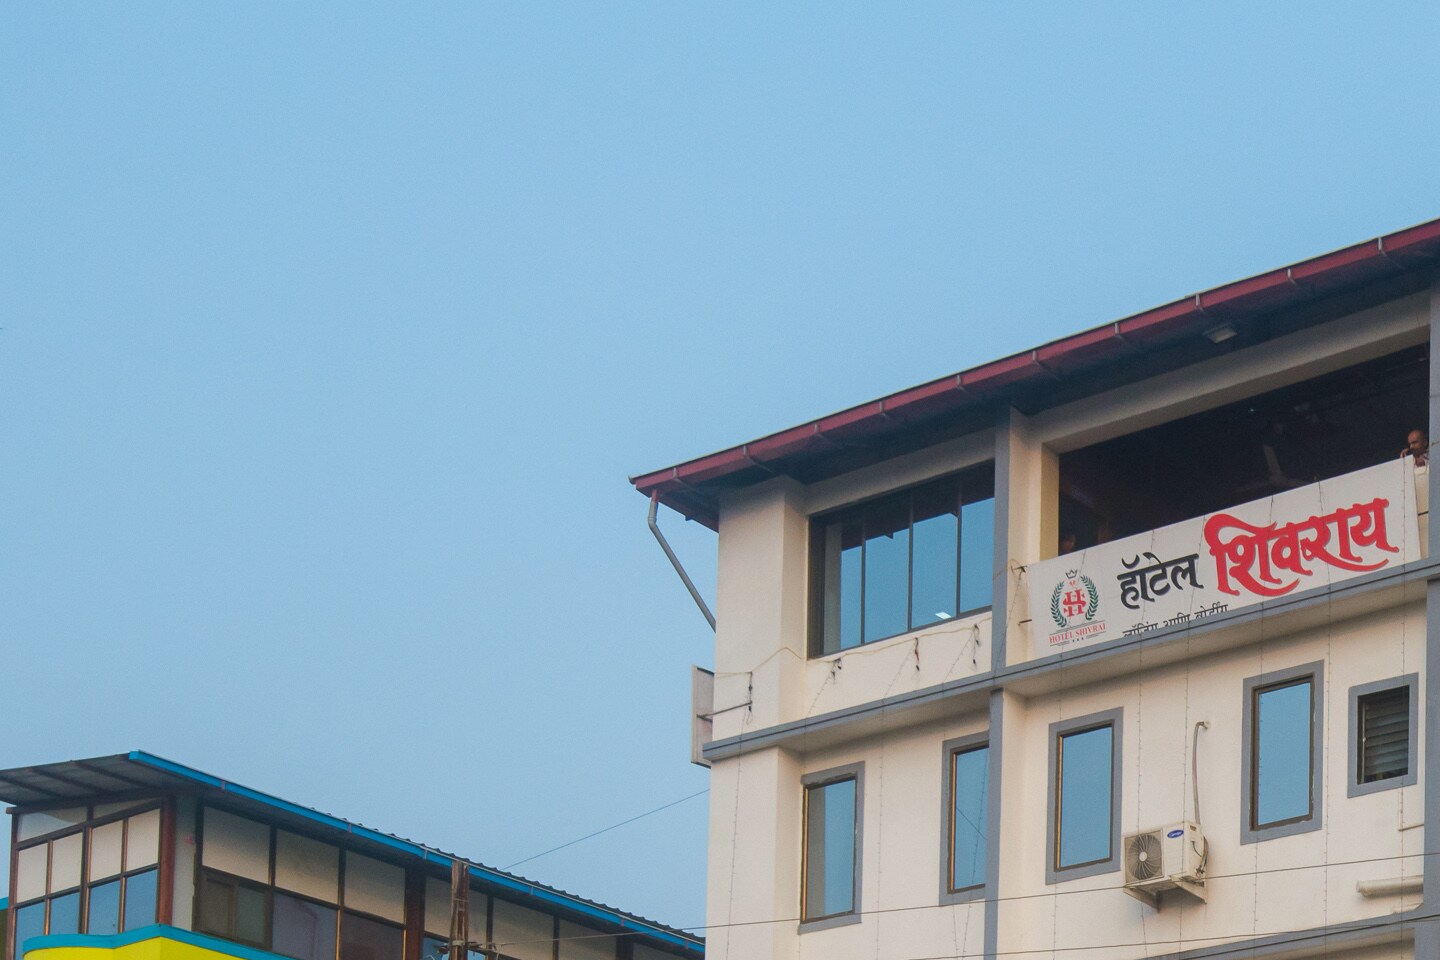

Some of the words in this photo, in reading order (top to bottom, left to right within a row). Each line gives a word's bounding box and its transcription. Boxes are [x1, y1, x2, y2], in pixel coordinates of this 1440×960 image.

[1118, 552, 1204, 610] हॉटेल
[1204, 497, 1400, 597] शिवराय
[1049, 631, 1074, 645] HOTEL
[1075, 622, 1106, 639] SHIVRAI
